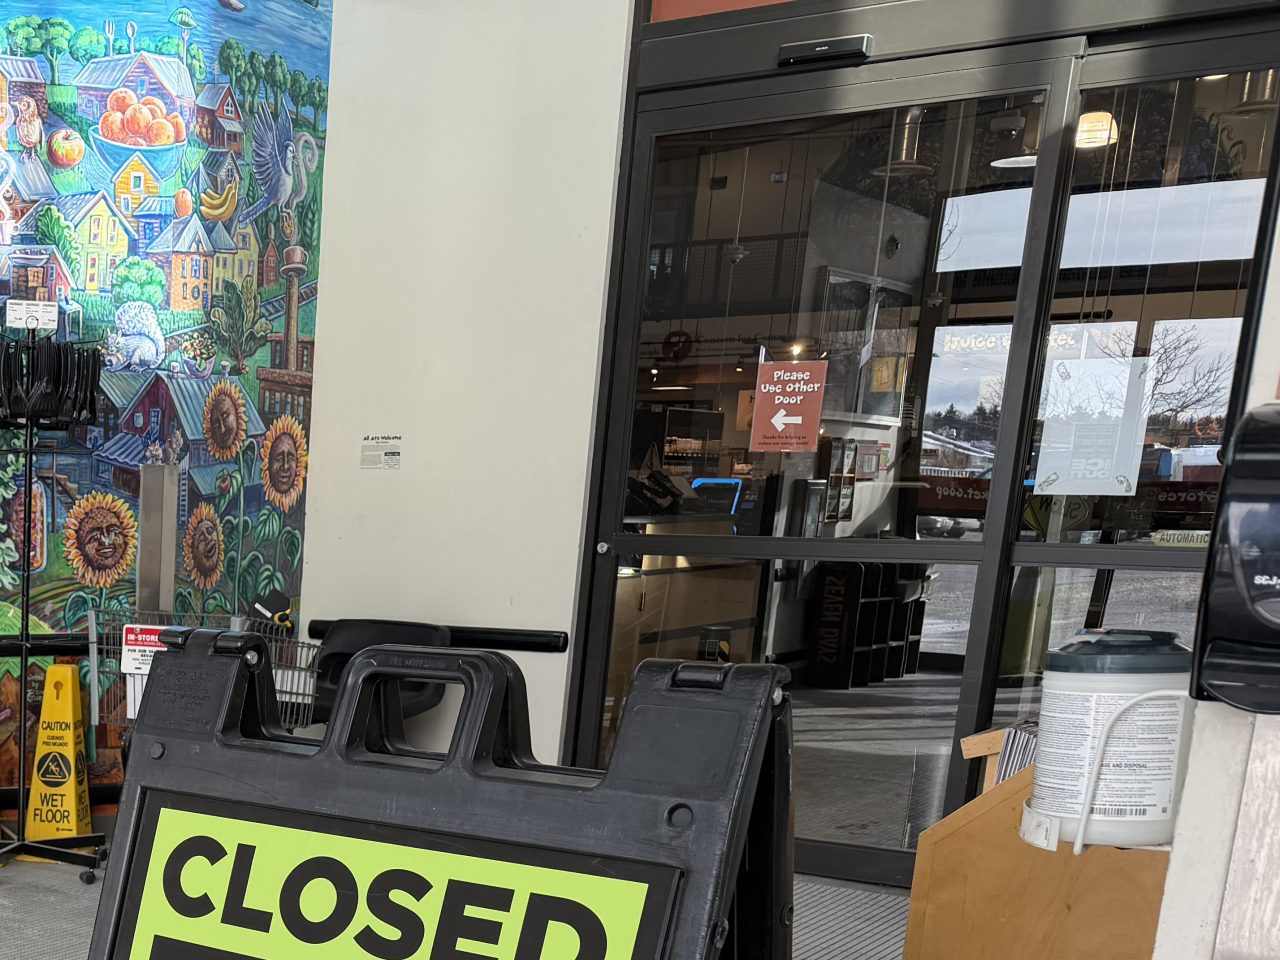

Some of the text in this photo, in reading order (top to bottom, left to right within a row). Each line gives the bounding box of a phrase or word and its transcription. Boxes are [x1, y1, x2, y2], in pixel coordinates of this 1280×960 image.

[773, 370, 811, 381] Please
[761, 381, 820, 393] Use Other
[774, 395, 803, 404] Door
[1159, 532, 1209, 544] AUTOMATIC
[41, 721, 70, 731] CAUTION
[39, 793, 66, 808] WET
[33, 809, 70, 824] FLOOR
